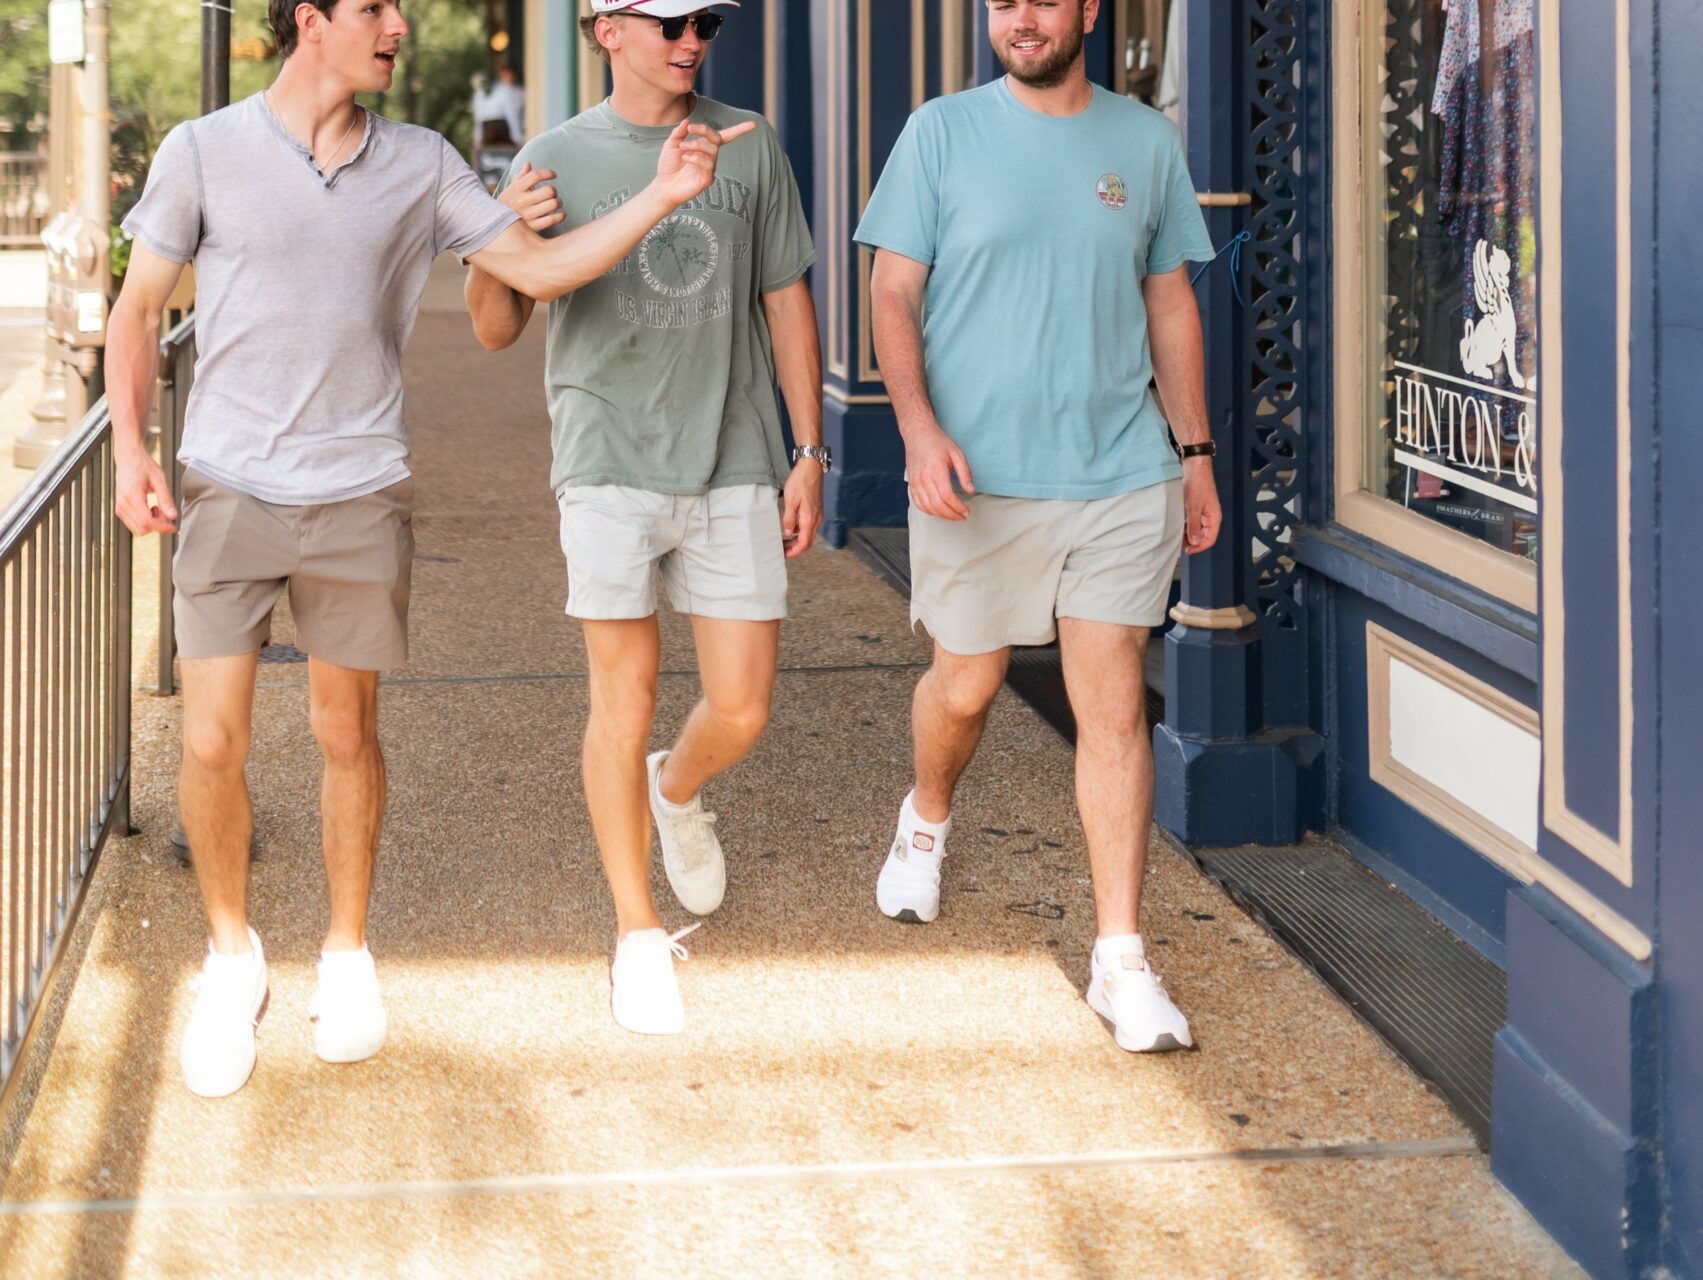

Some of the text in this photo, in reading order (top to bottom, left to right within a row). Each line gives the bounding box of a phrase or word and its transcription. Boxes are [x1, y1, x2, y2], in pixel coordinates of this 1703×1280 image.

[615, 289, 640, 325] U.S.
[642, 299, 690, 329] VIRGIN
[1394, 376, 1538, 493] HINTON &
[1436, 504, 1471, 517] SMATHERS
